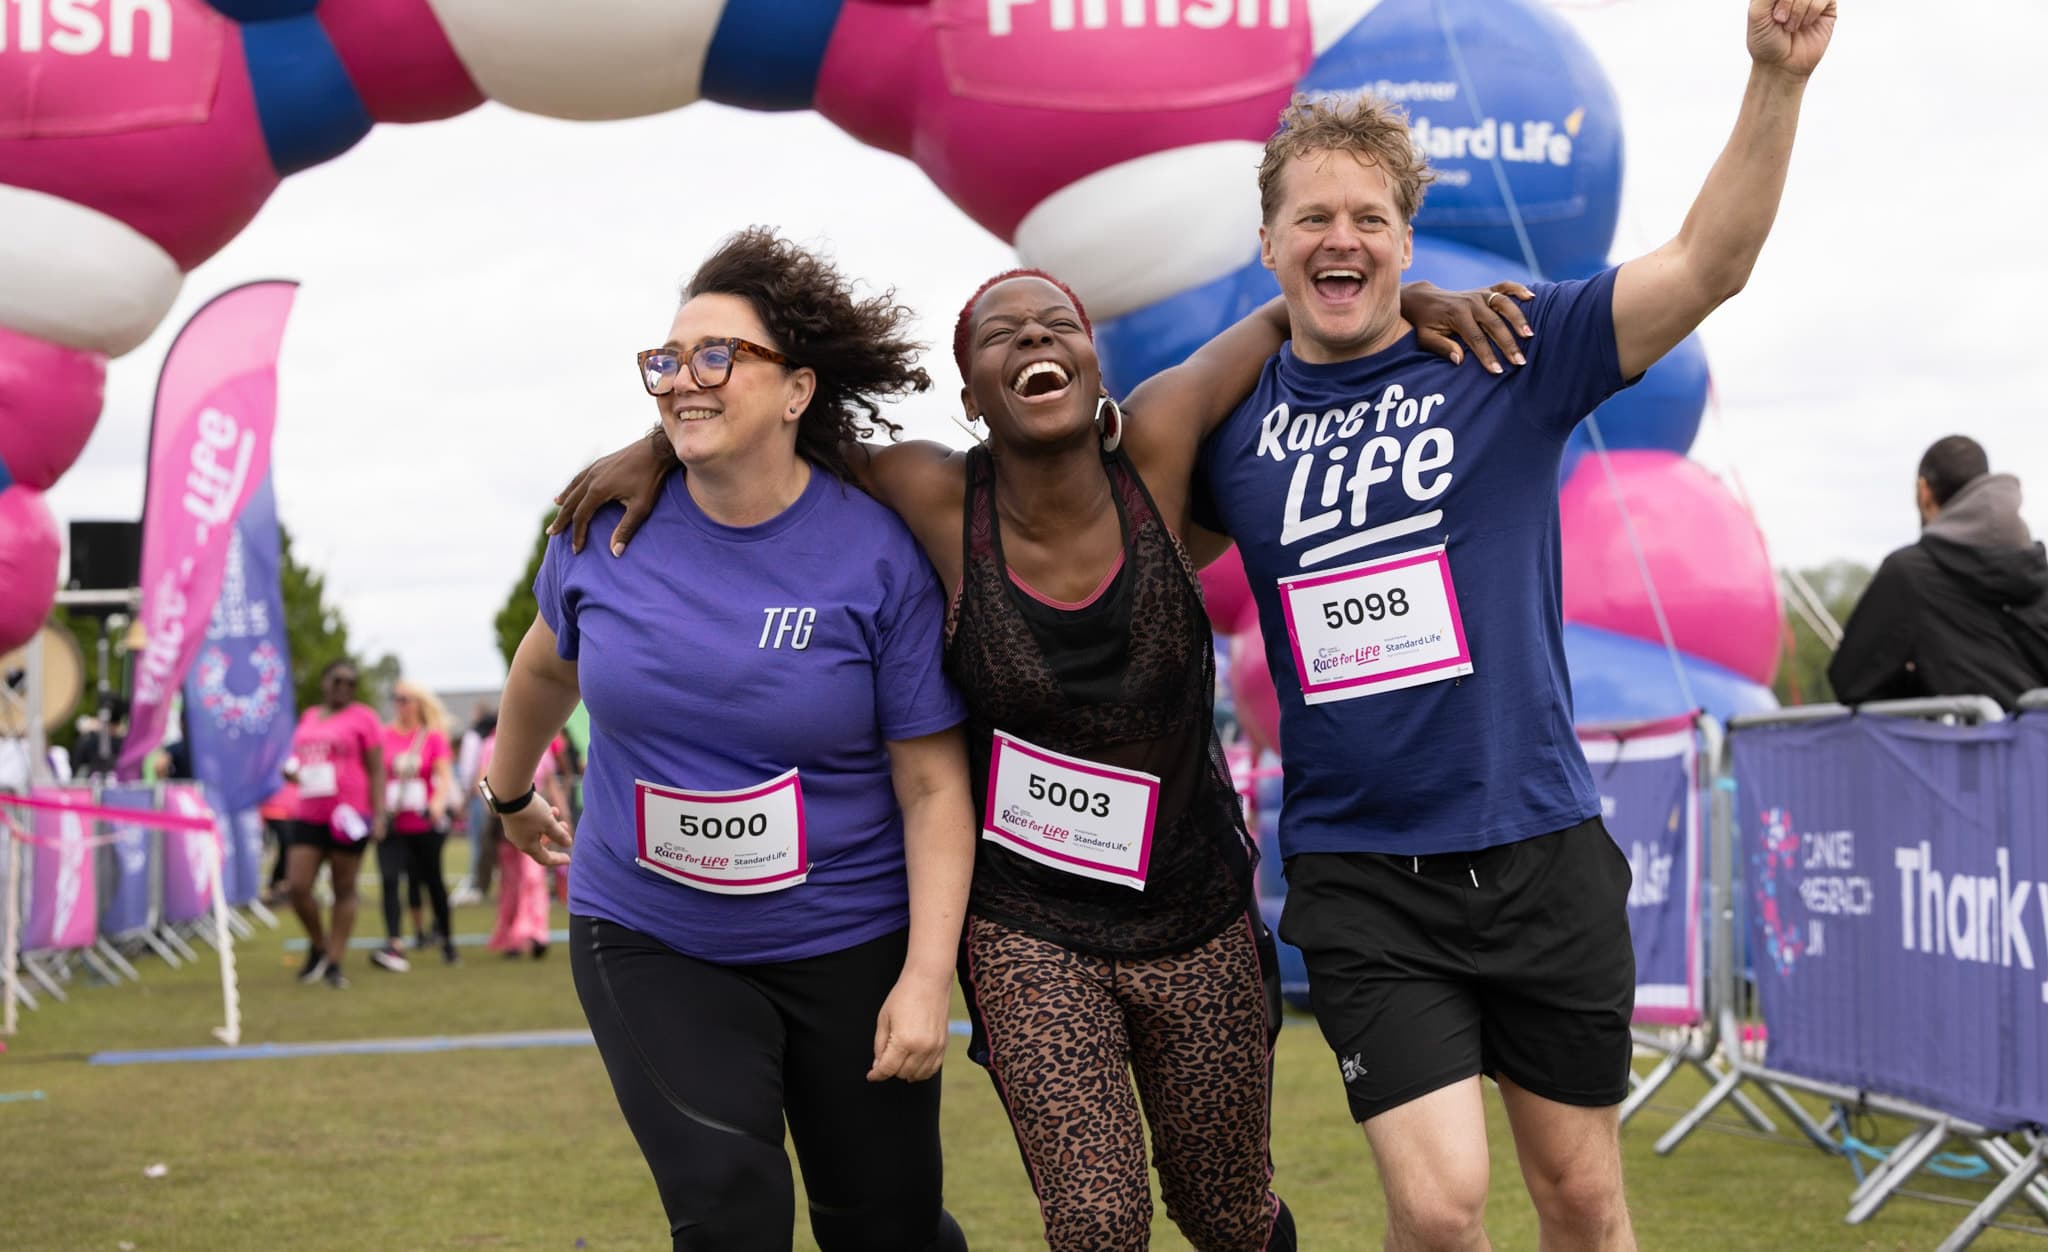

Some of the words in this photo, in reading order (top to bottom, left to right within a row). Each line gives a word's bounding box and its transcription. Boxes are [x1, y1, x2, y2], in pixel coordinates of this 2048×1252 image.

[1501, 120, 1572, 166] Life
[1257, 401, 1370, 461] Race
[1374, 383, 1445, 432] for
[1280, 427, 1454, 545] Life
[1322, 587, 1410, 630] 5098
[758, 607, 817, 650] TFG
[1385, 636, 1424, 653] Standard
[1424, 633, 1441, 644] Life
[1313, 656, 1339, 673] Race
[1340, 653, 1354, 665] for
[1355, 645, 1380, 663] Life
[1028, 773, 1111, 818] 5003
[679, 813, 767, 839] 5000
[1002, 809, 1028, 828] Race
[1029, 820, 1043, 831] for
[1043, 823, 1069, 840] Life
[1073, 834, 1111, 849] Standard
[1111, 841, 1128, 852] Life
[654, 843, 684, 861] Race
[684, 854, 700, 864] for
[700, 855, 729, 867] Life
[733, 853, 771, 866] Standard
[772, 850, 787, 860] Life
[1894, 839, 2035, 970] Thank
